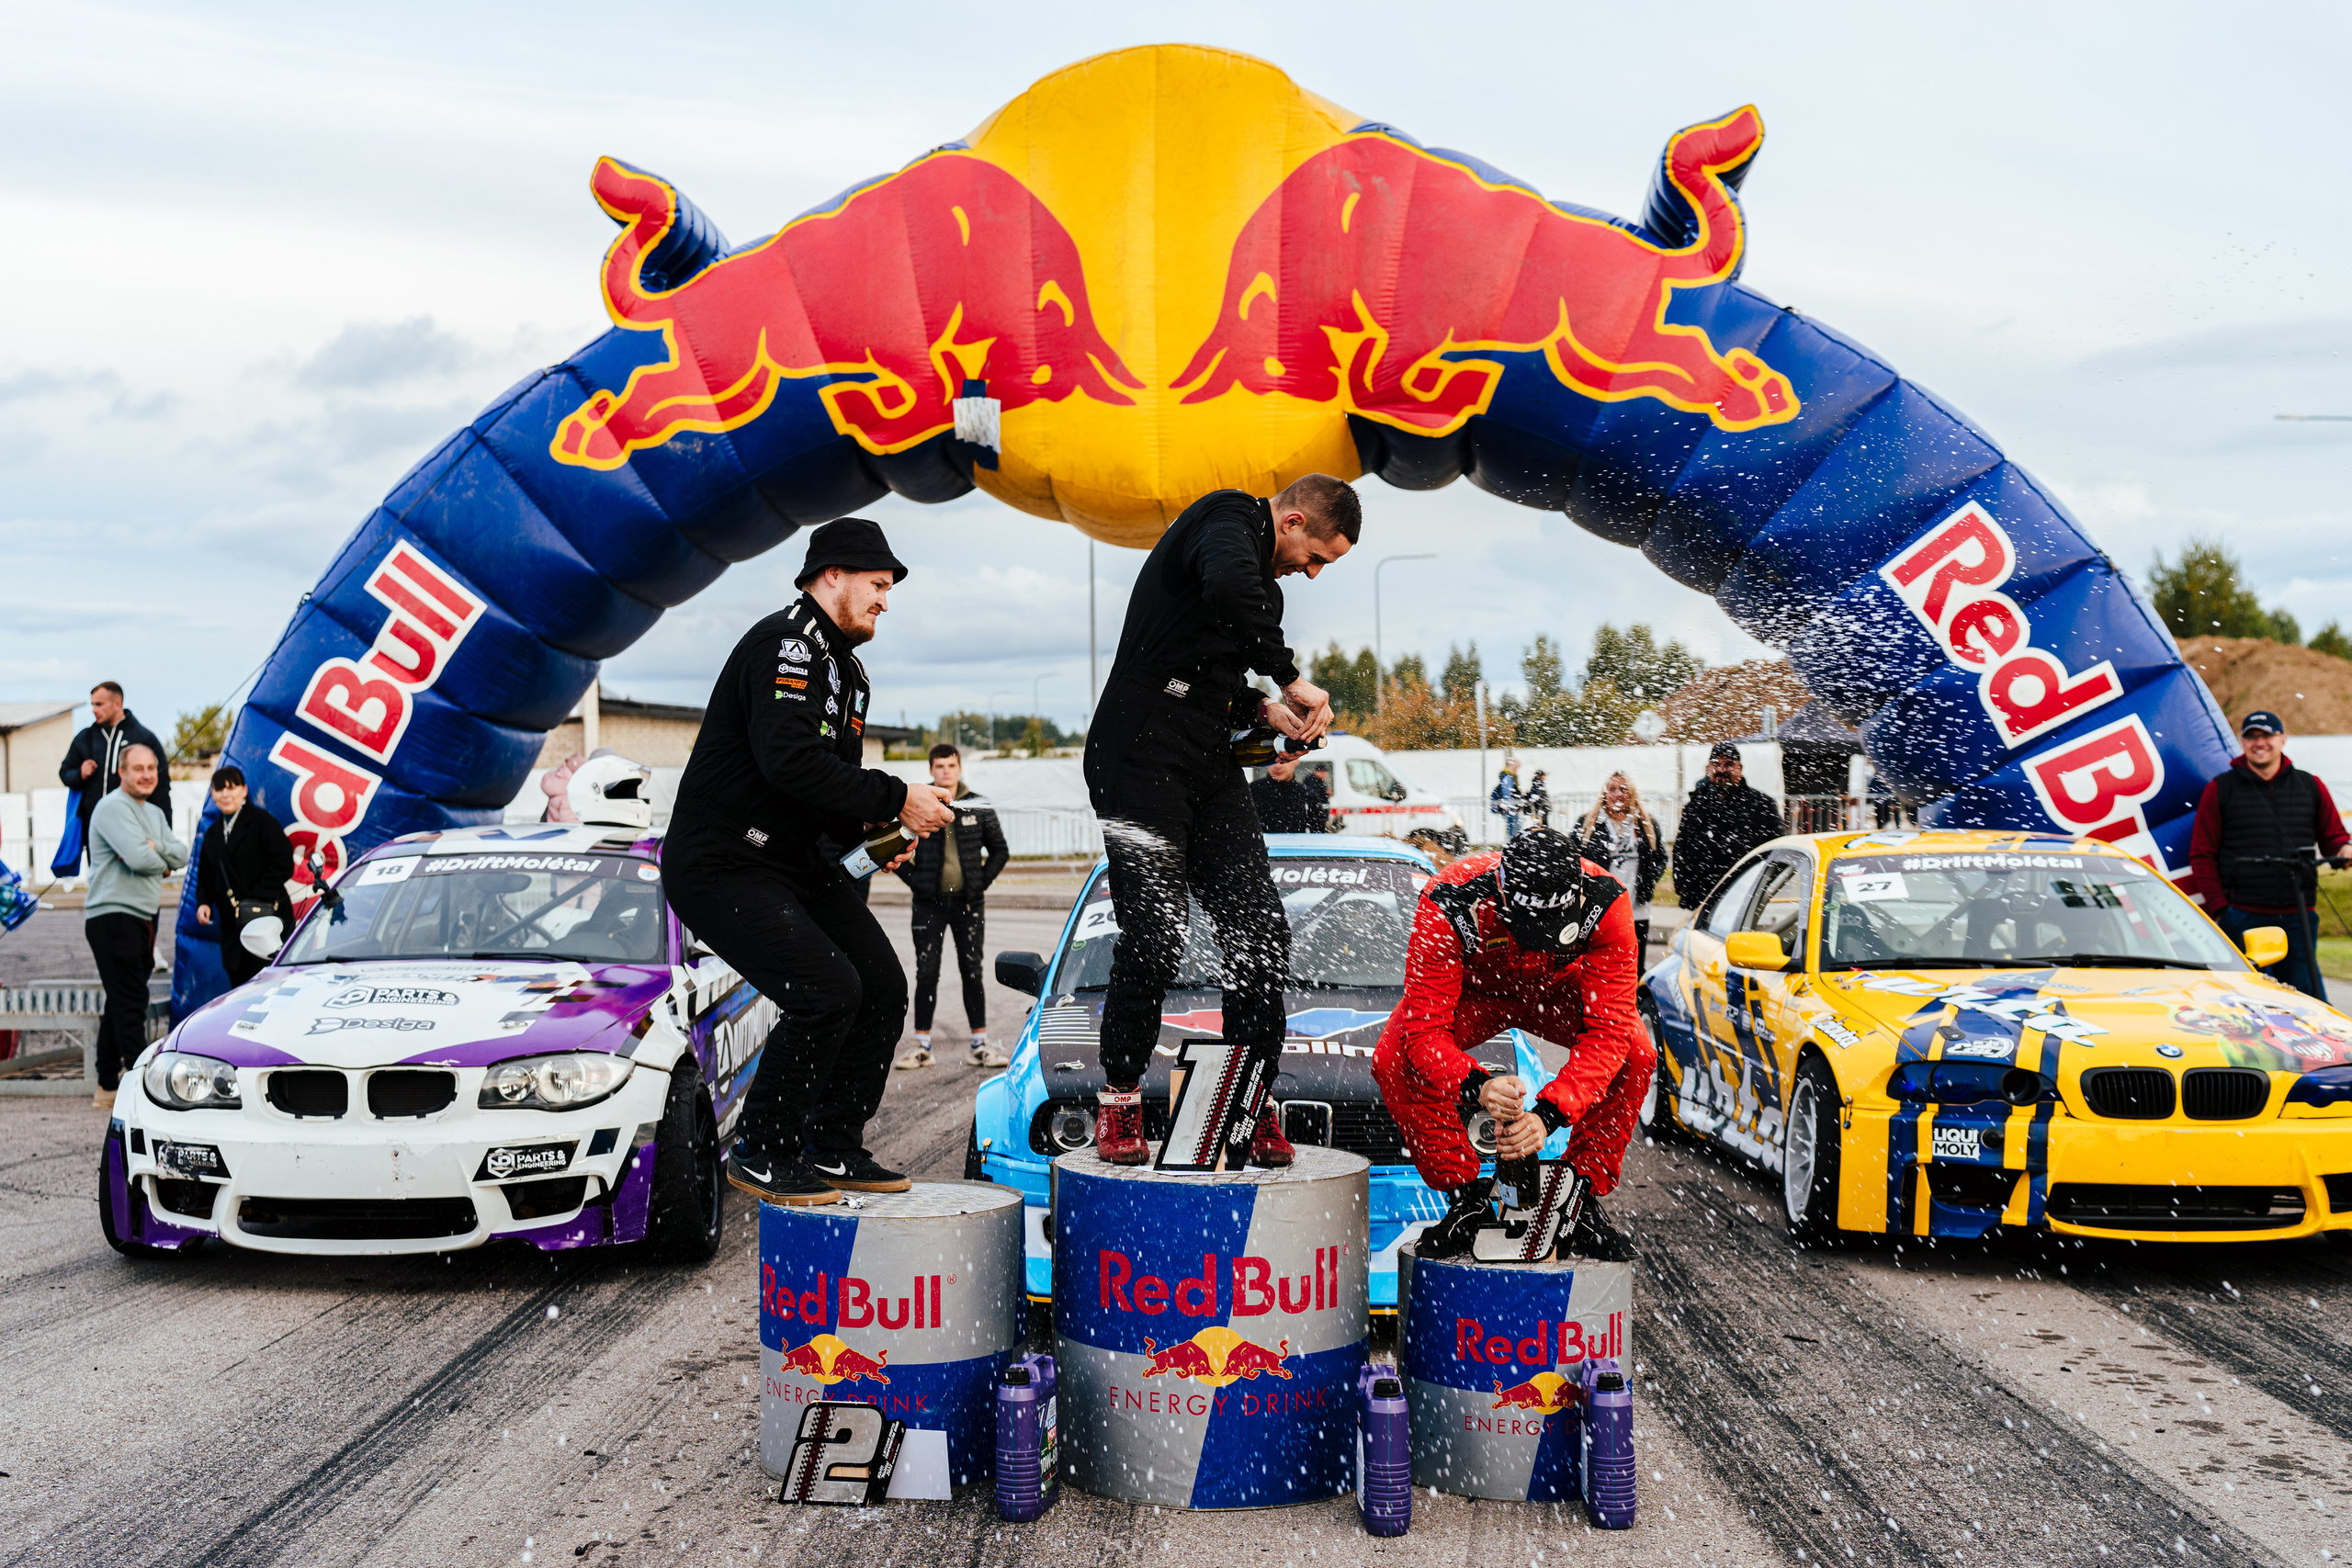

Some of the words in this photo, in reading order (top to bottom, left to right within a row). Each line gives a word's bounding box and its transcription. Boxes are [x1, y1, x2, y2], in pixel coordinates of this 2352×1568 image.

[1879, 501, 2123, 749] Red
[296, 539, 487, 765] Bull
[1168, 680, 1190, 693] OMP
[268, 731, 382, 922] ed
[747, 829, 768, 842] OMP
[376, 864, 405, 876] 18
[1858, 881, 1893, 893] 27
[1578, 905, 1601, 941] sparco
[372, 997, 456, 1006] ENGINEERING
[374, 987, 440, 1000] PARTS
[441, 991, 457, 1002] &
[343, 1017, 436, 1032] Desiga
[1114, 1095, 1132, 1103] OMP
[1160, 1043, 1250, 1166] 1
[1244, 1119, 1256, 1140] 2022
[1934, 1127, 1978, 1143] LIQUI
[517, 1151, 555, 1163] PARTS
[557, 1149, 566, 1159] &
[1934, 1143, 1976, 1156] MOLY
[517, 1159, 567, 1169] ENGINEERING
[1100, 1248, 1217, 1317] Red
[1232, 1245, 1339, 1317] Bull
[763, 1262, 827, 1326] Red
[838, 1275, 941, 1330] Bull
[1456, 1316, 1548, 1366] Red
[1557, 1311, 1623, 1365] Bull
[767, 1376, 836, 1404] ENERGY
[1109, 1386, 1228, 1416] ENERGY
[1244, 1386, 1329, 1416] DRINK
[1464, 1416, 1556, 1436] ENERGY
[783, 1404, 883, 1503] 2
